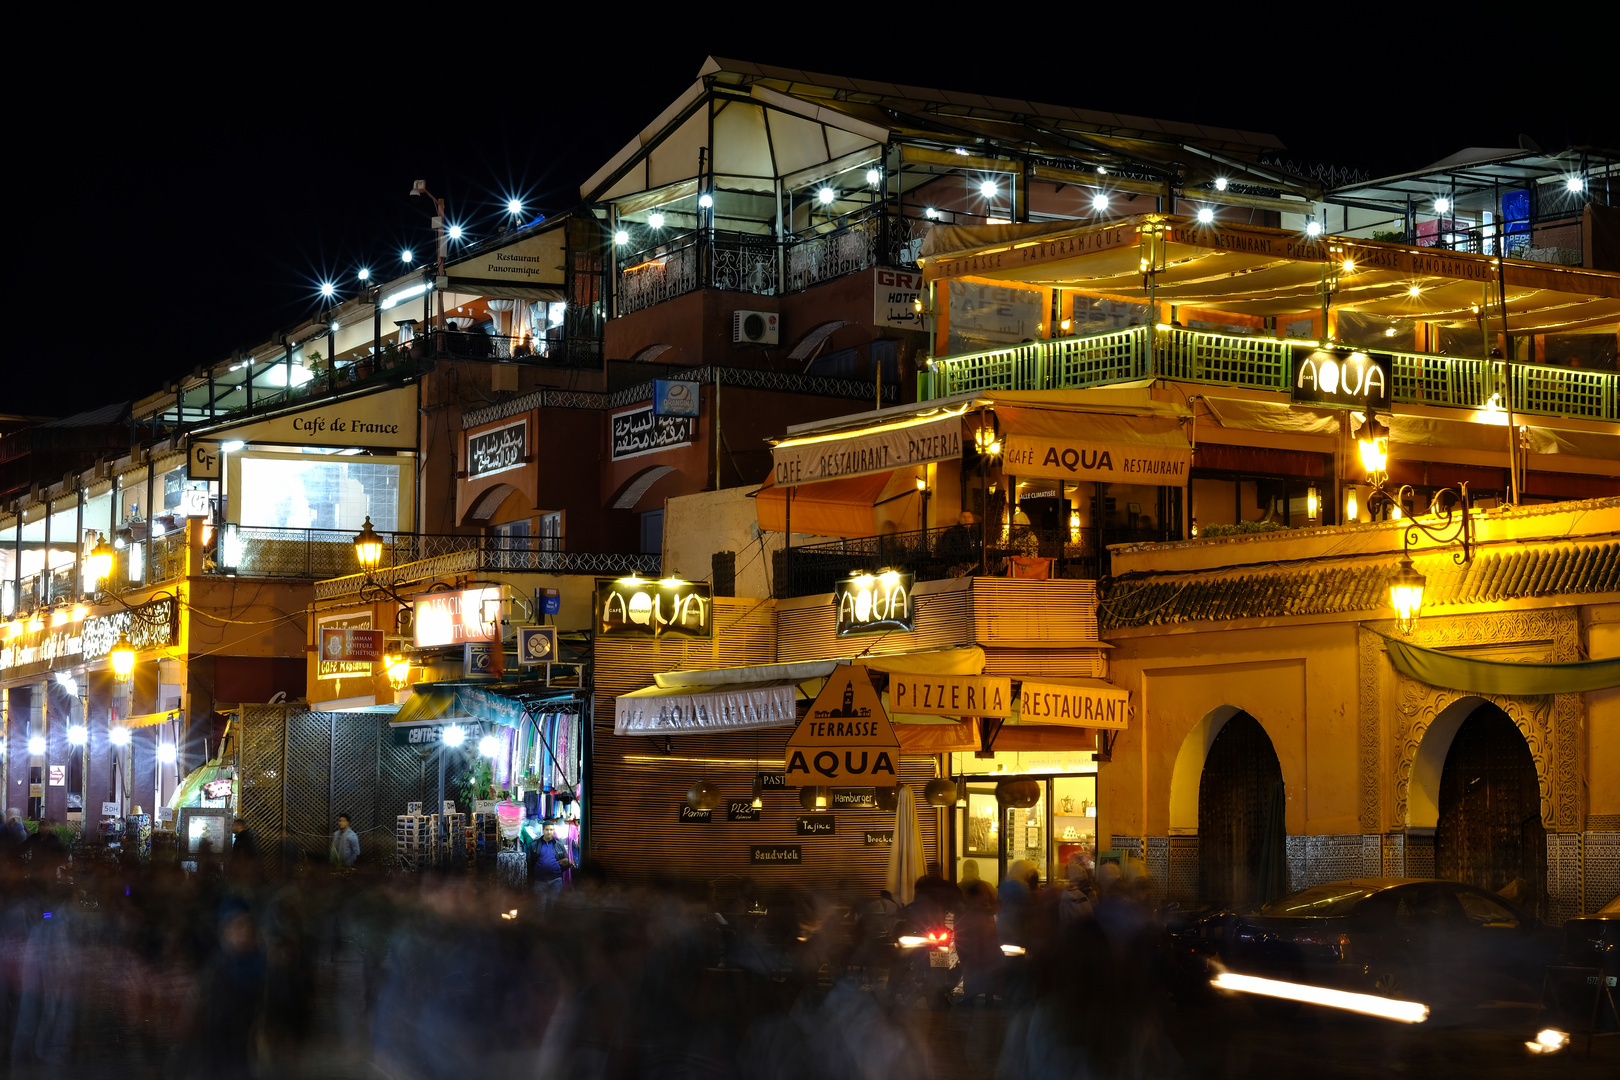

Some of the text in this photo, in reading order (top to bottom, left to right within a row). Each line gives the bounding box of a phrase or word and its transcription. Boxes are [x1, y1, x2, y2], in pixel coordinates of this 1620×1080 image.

[496, 252, 540, 263] Restaurant
[938, 229, 1122, 277] TERRASSE PANORAMIQUE
[1214, 233, 1272, 253] RESTAURANT
[1287, 242, 1327, 261] PIZZERIA
[487, 264, 540, 277] Panoramique
[1413, 256, 1487, 279] PANORAMIQUE
[877, 270, 930, 293] GRA
[1297, 358, 1385, 399] AQUA
[293, 417, 399, 436] Café de France
[820, 446, 889, 477] RESTAURANT
[908, 432, 960, 463] PIZZERIA
[1042, 447, 1114, 472] AQUA
[1123, 459, 1185, 475] RESTAURANT
[602, 591, 705, 626] AQUA
[840, 585, 908, 622] AQUA
[897, 682, 1003, 711] PIZZERIA
[1022, 691, 1127, 722] RESTAURANT
[657, 704, 709, 729] AQUA
[724, 700, 790, 722] RESTAURANT
[408, 726, 437, 744] CENTRE
[810, 722, 878, 737] TERRASSE
[786, 750, 896, 778] AQUA
[763, 775, 786, 785] PAST
[408, 802, 415, 814] 3
[834, 791, 873, 805] Hamburger
[682, 806, 710, 818] Panini
[803, 820, 831, 833] Tajine
[867, 834, 894, 842] Broche
[755, 849, 799, 860] Sandwich
